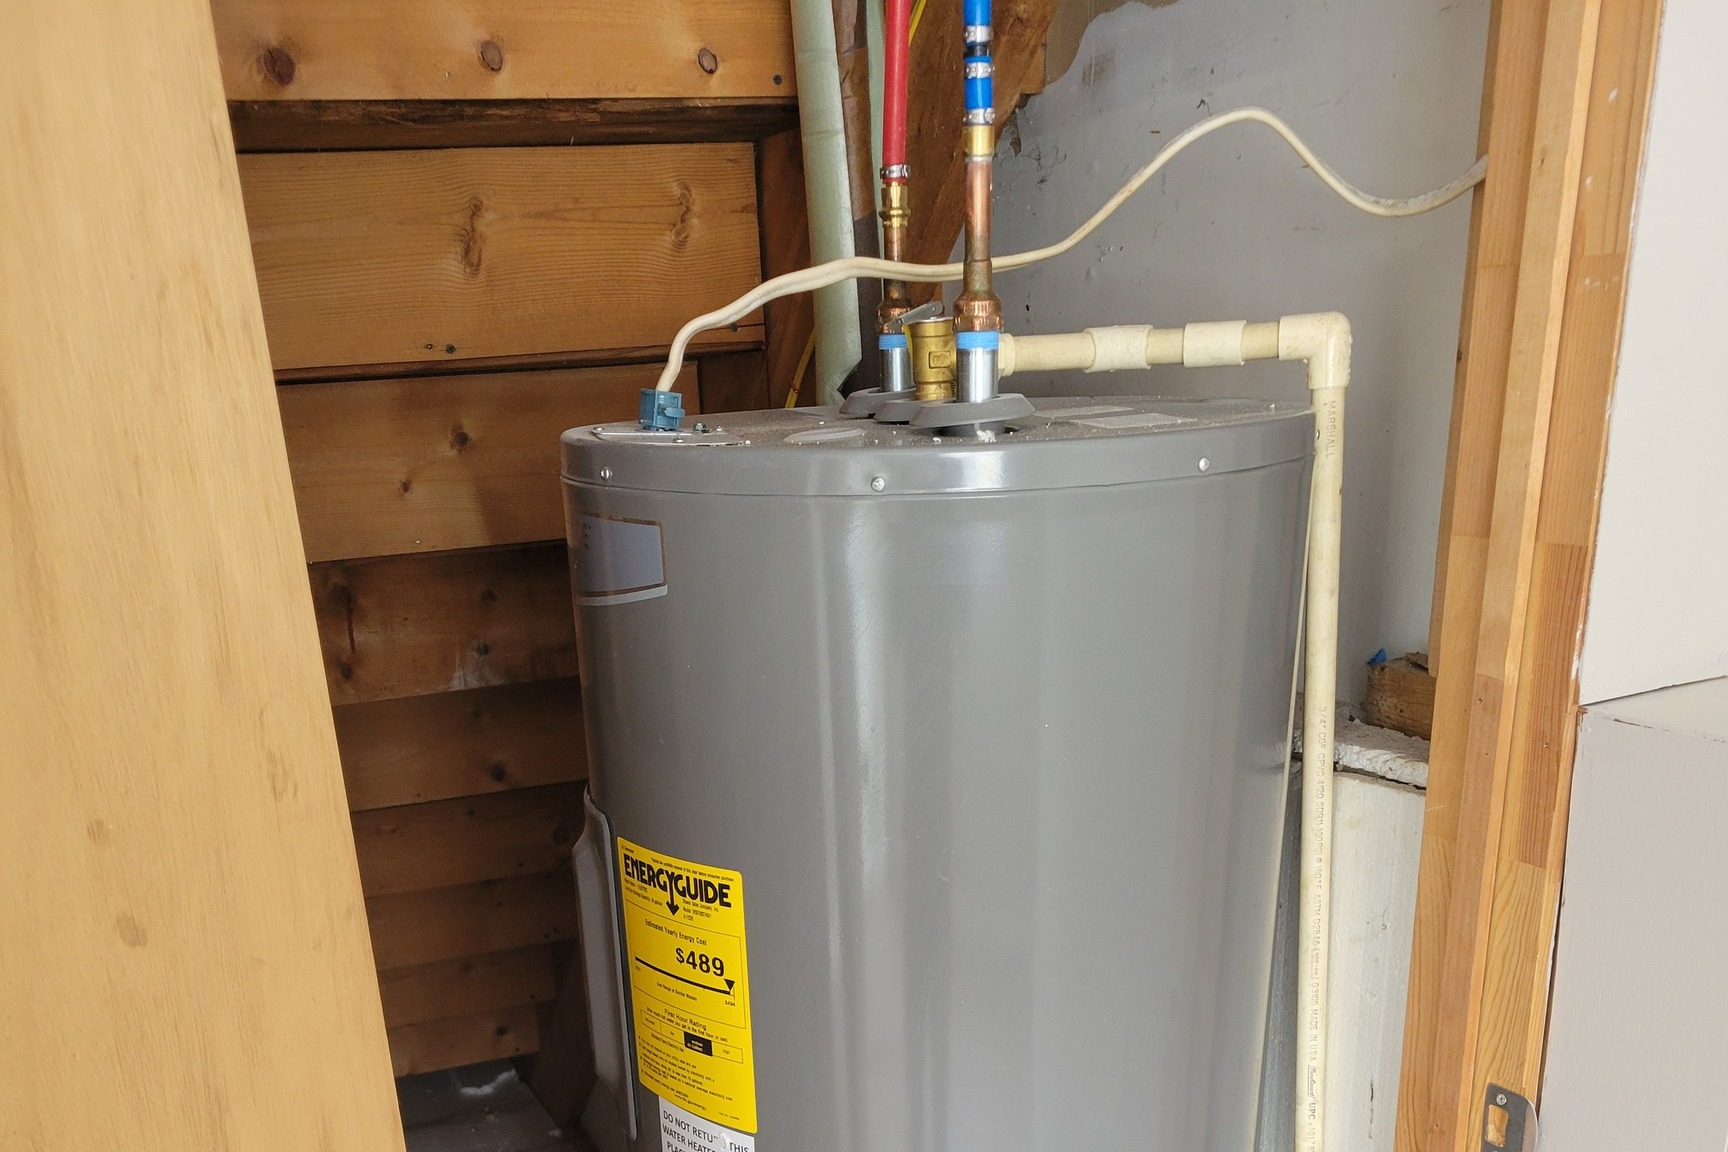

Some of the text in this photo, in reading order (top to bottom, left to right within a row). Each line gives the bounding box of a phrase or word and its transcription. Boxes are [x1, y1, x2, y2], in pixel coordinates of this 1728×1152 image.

[1326, 400, 1337, 460] MARSHALL
[1316, 753, 1325, 777] CPVC
[1316, 779, 1325, 800] 4120
[623, 853, 732, 908] ENERGYGUIDE
[1313, 894, 1321, 917] ASTM
[645, 919, 707, 946] Estimated Yearly Energy Cost
[1312, 919, 1321, 946] D2846
[676, 948, 724, 977] $489
[664, 1008, 707, 1031] First Hour Rating
[1310, 1009, 1318, 1031] MADE
[1309, 1034, 1318, 1042] IN
[1309, 1045, 1317, 1061] USA
[663, 1110, 673, 1123] DO
[675, 1118, 690, 1132] NOT
[1308, 1102, 1316, 1120] UPC
[662, 1124, 686, 1146] WATER
